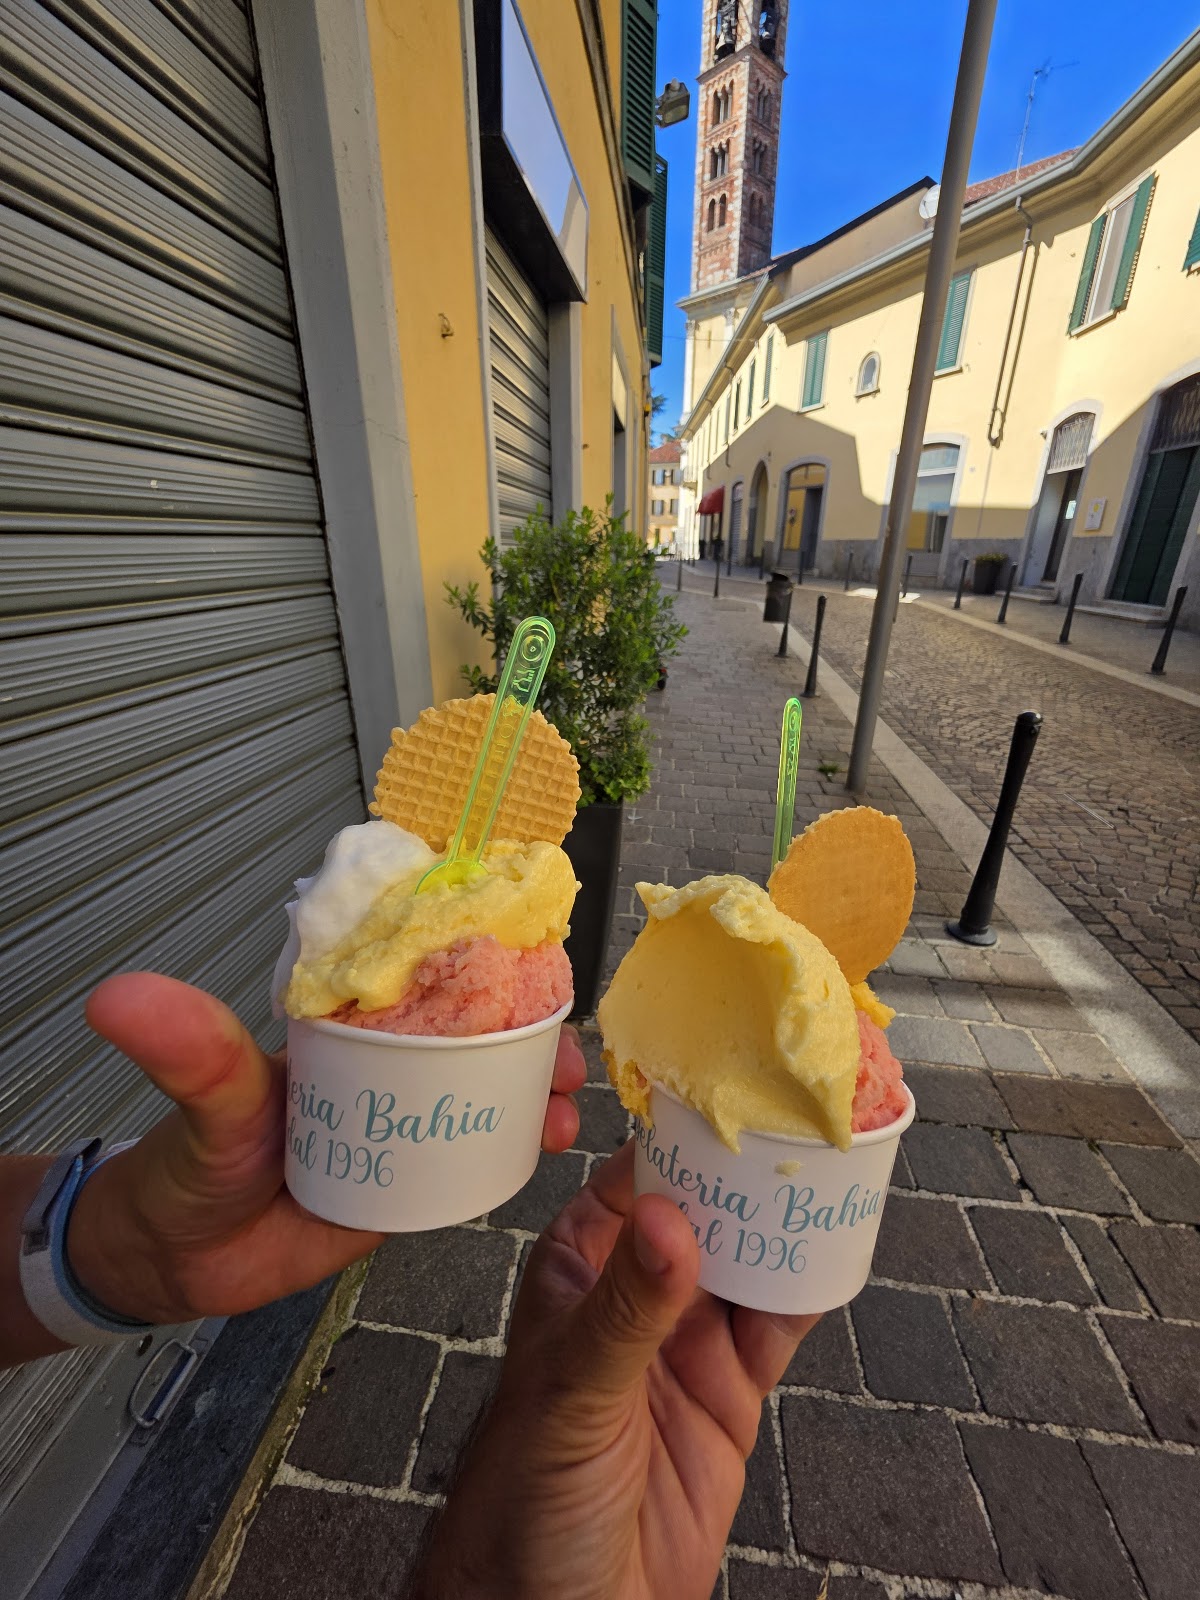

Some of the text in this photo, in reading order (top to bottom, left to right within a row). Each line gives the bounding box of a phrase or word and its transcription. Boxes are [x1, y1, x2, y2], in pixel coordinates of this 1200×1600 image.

[356, 1089, 505, 1143] Bahia
[325, 1139, 394, 1187] 1996
[774, 1184, 881, 1233] Bahia
[733, 1229, 808, 1273] 1996
